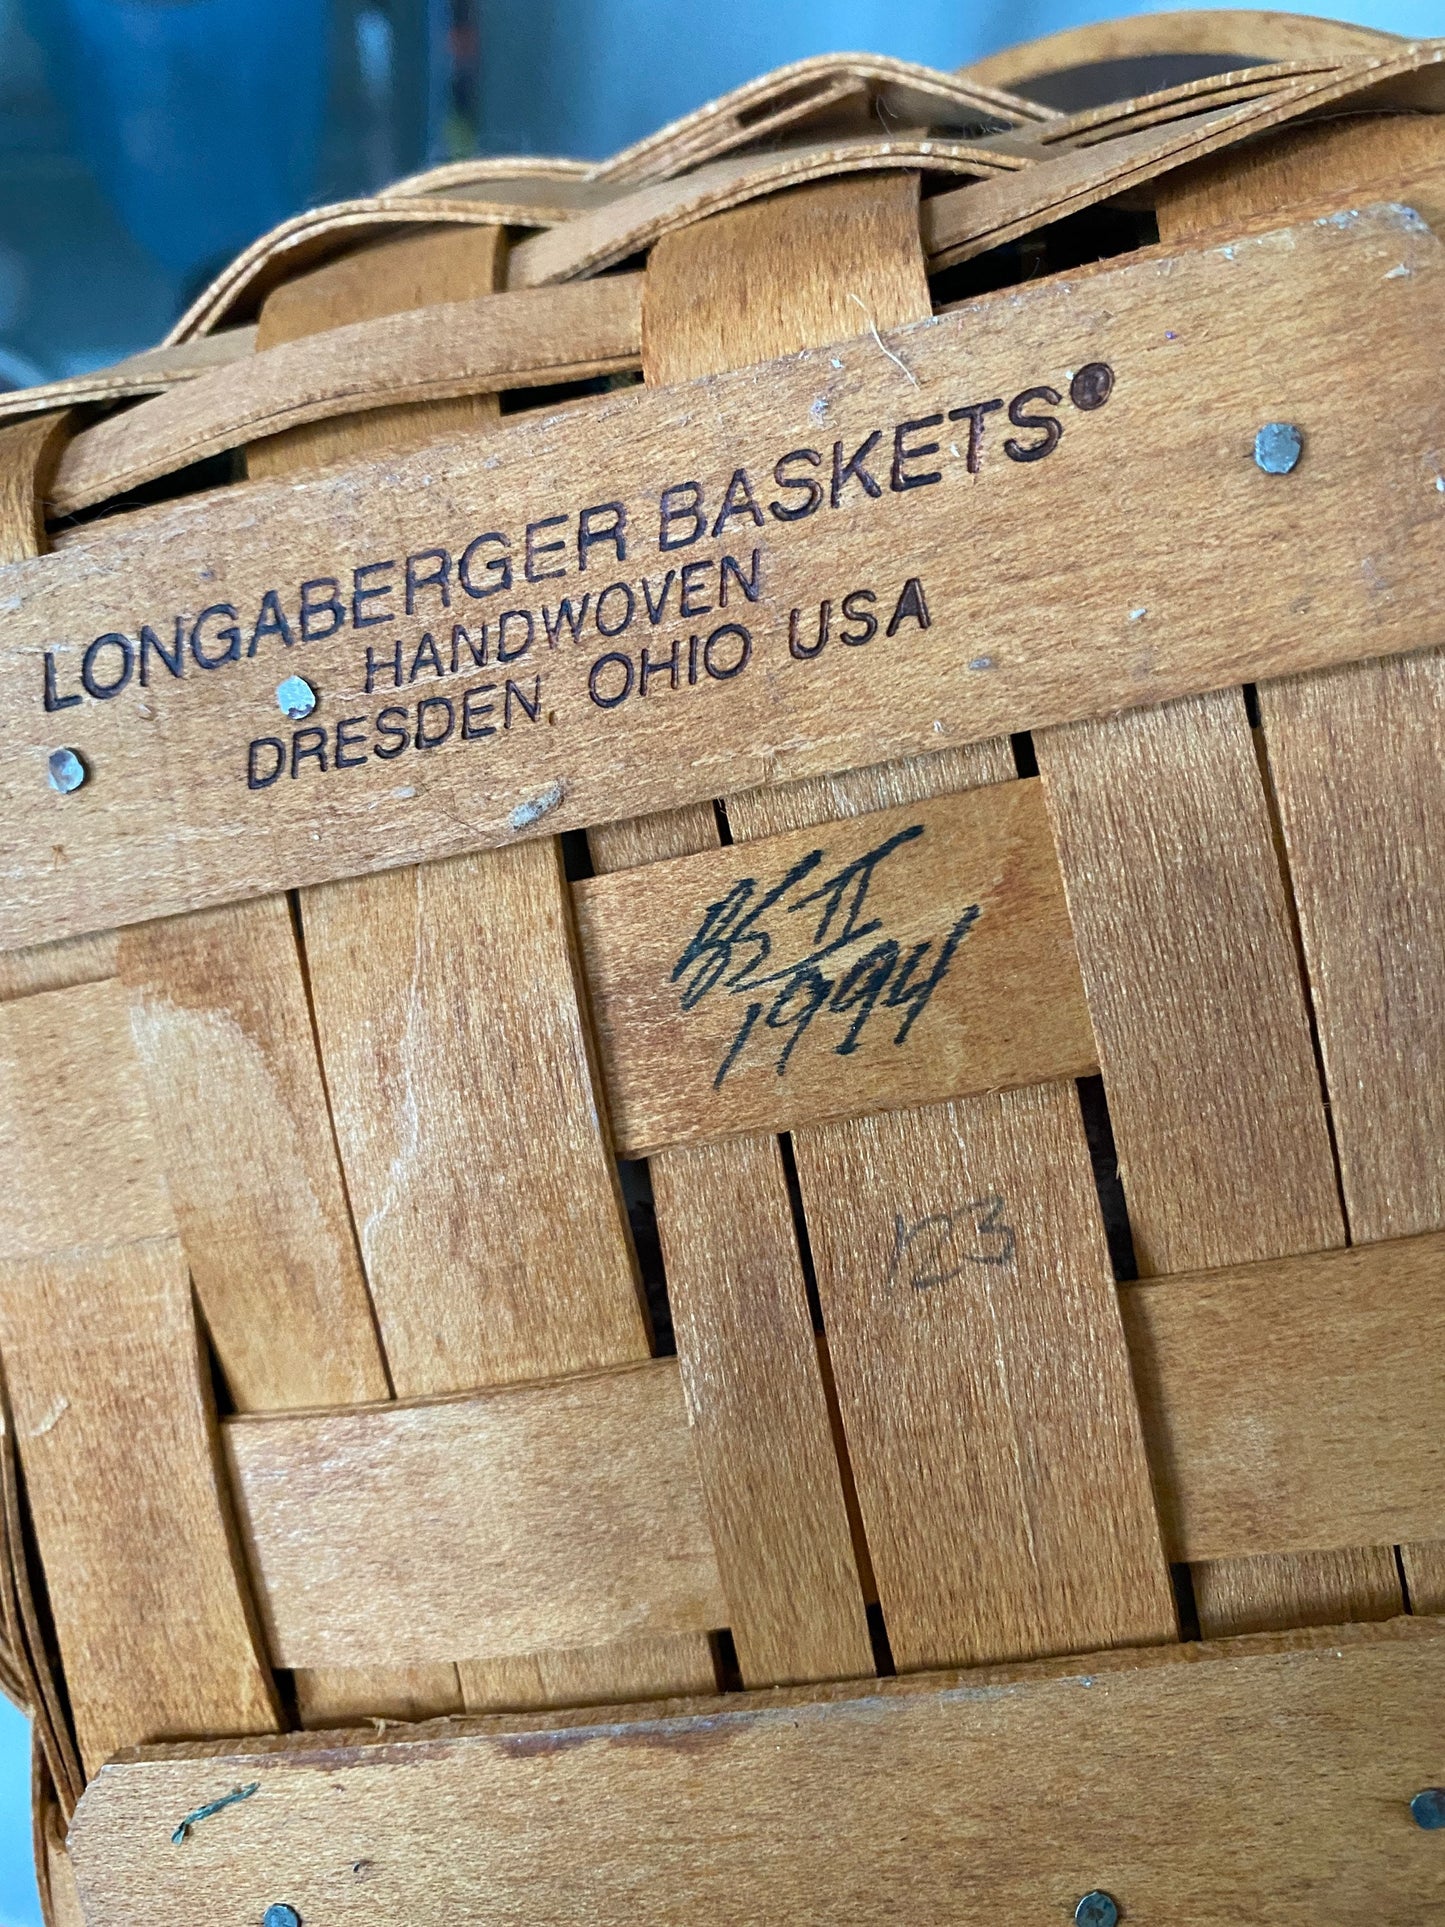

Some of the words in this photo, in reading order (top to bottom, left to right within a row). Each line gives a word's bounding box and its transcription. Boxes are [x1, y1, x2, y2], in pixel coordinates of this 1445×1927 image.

[43, 500, 628, 713] LONGABERGER
[247, 673, 542, 790] DRESDEN
[588, 623, 753, 708] OHIO
[788, 577, 932, 660] USA
[364, 547, 761, 693] HANDWOVEN
[711, 903, 983, 1091] 1994
